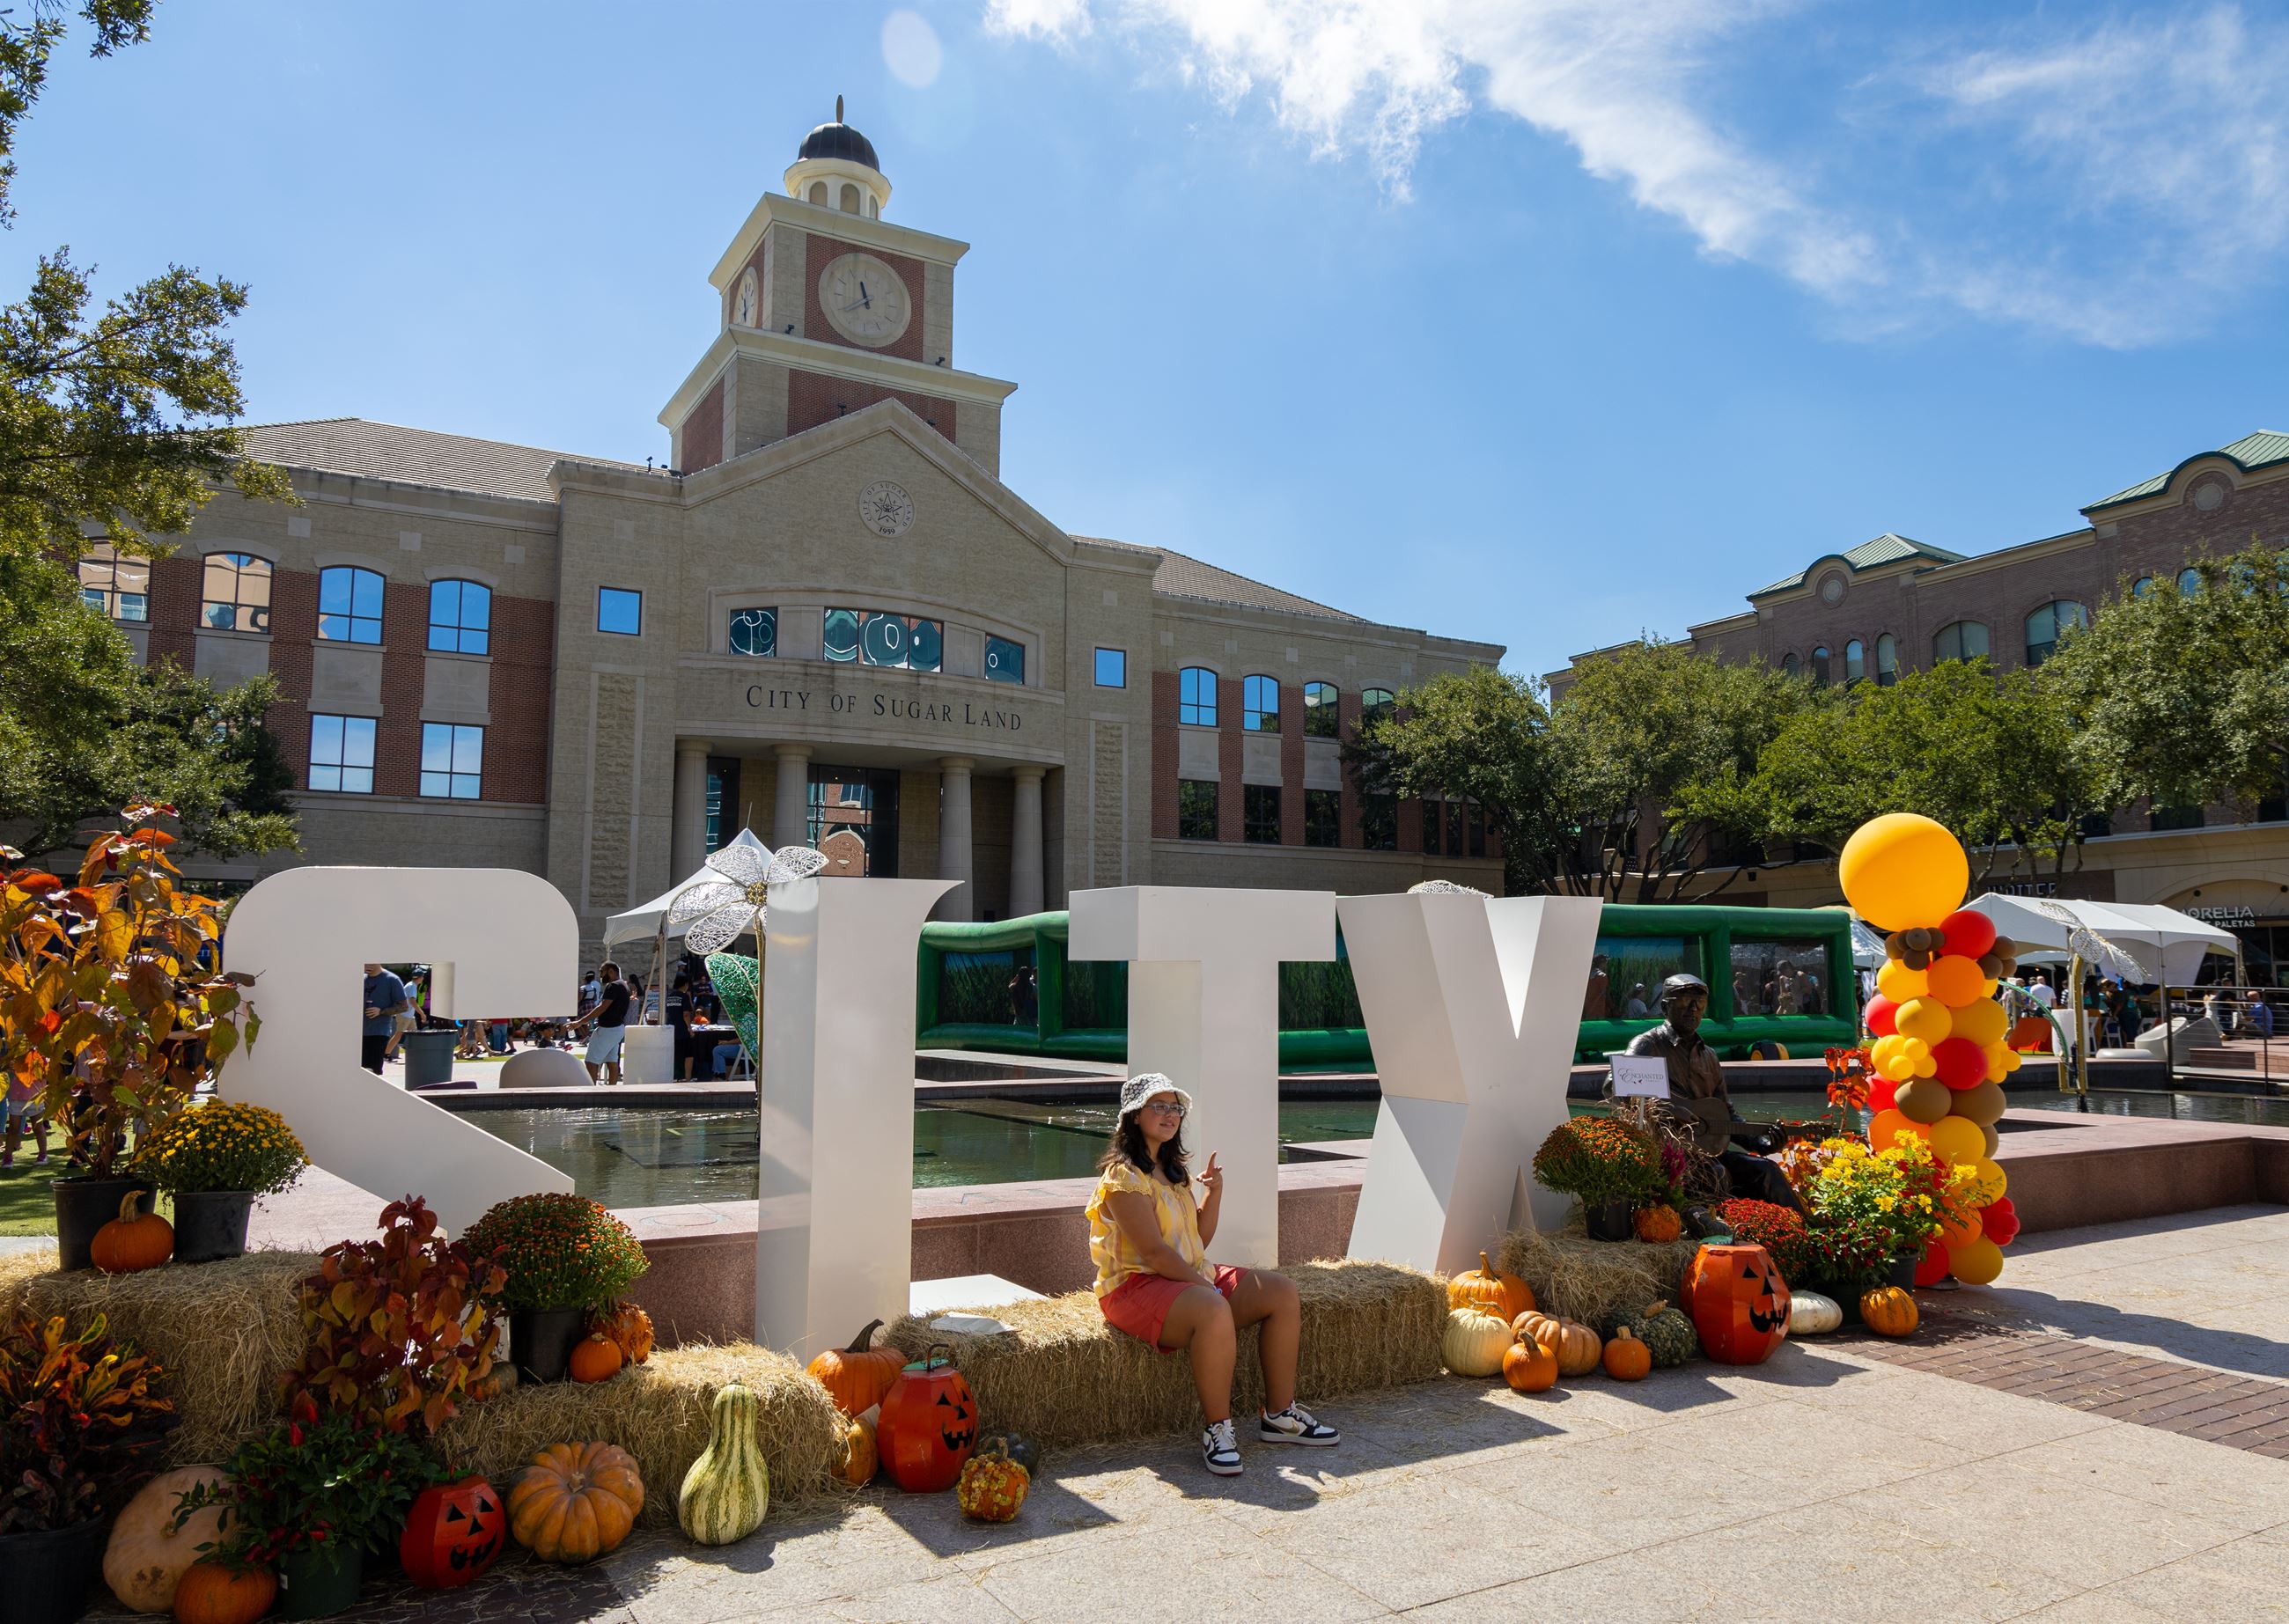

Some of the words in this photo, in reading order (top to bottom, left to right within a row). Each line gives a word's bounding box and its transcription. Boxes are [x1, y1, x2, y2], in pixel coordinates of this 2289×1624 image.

[880, 482, 907, 499] SUGAR
[902, 503, 912, 527] LAND
[879, 526, 895, 535] 1959
[746, 685, 811, 709] CITY
[830, 694, 857, 712] OF
[873, 694, 953, 722] SUGAR
[964, 704, 1021, 730] LAND
[2182, 906, 2255, 920] ORELIA
